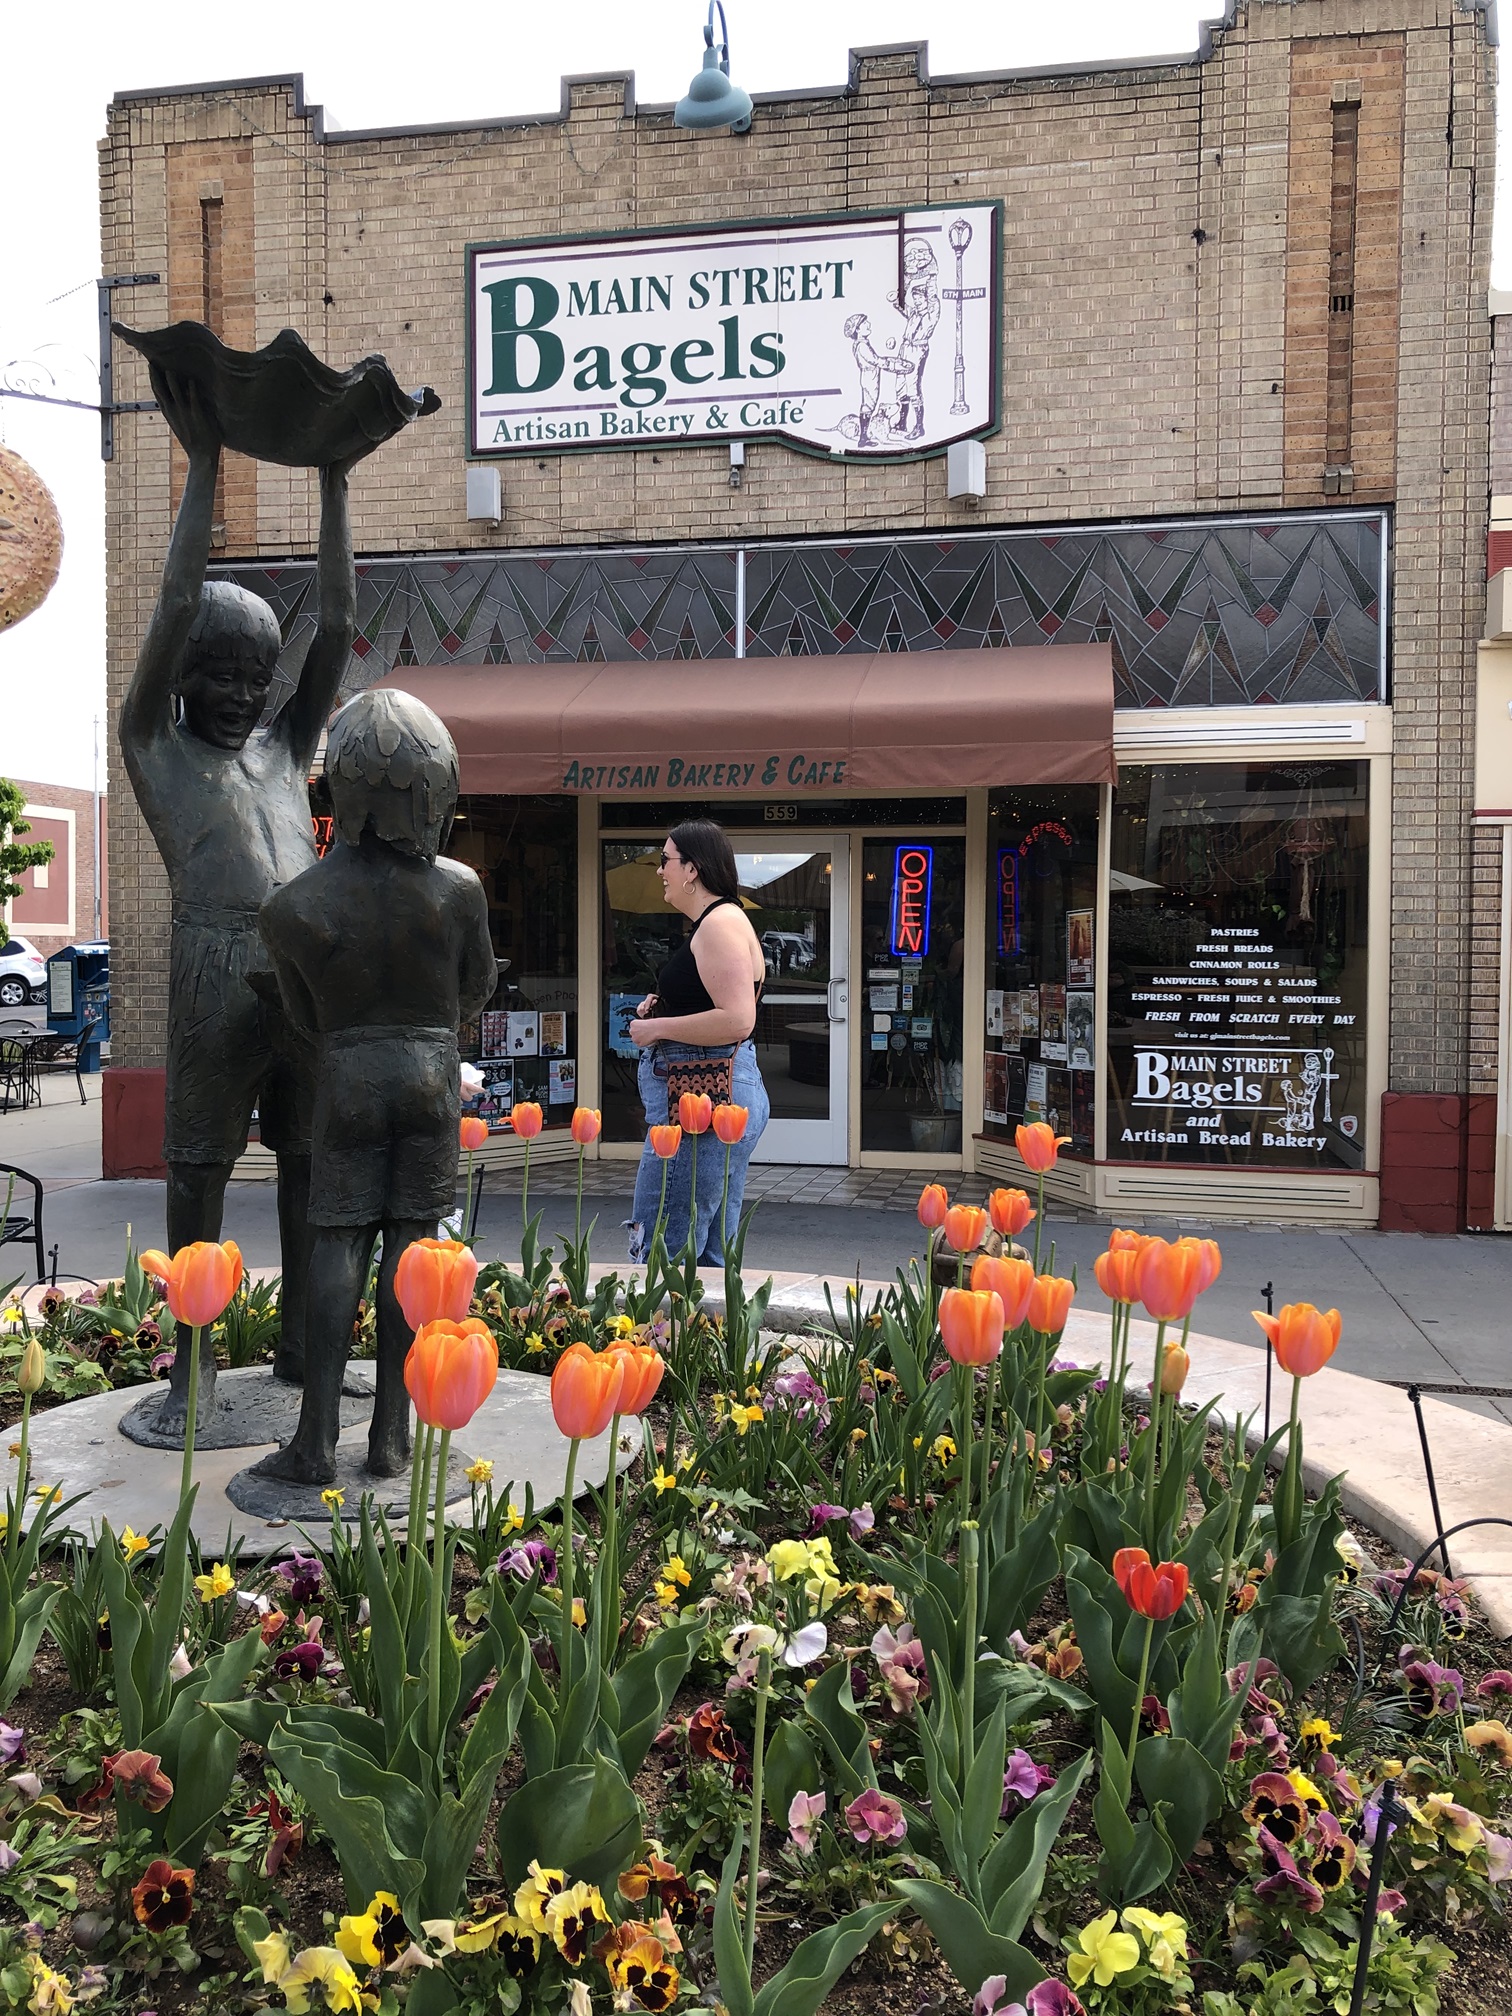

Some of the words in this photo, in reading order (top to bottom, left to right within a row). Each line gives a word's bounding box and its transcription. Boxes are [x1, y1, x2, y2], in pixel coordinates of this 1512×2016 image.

[566, 275, 673, 318] MAIN
[688, 260, 853, 309] STREET
[962, 289, 984, 298] MAIN
[481, 276, 787, 409] Bagels
[493, 418, 590, 444] Artisan
[599, 409, 695, 437] Bakery
[705, 405, 729, 428] &
[761, 756, 780, 785] &
[765, 806, 797, 819] 559
[899, 852, 927, 952] OPEN
[1210, 928, 1259, 937] PASTRIES
[1196, 945, 1229, 953] FRESH
[1233, 945, 1274, 953] BREADS
[1189, 961, 1243, 969] CINNAMON
[1247, 961, 1280, 970] ROLLS
[1152, 977, 1220, 987] SANDWICHES,
[1224, 978, 1259, 986] SOUPS
[1263, 978, 1272, 986] &
[1277, 978, 1318, 987] SALADS
[1131, 993, 1182, 1002] ESPRESSO
[1197, 994, 1230, 1002] FRESH
[1235, 994, 1263, 1003] JUICE
[1267, 995, 1276, 1003] &
[1282, 995, 1342, 1004] SMOOTHIES
[1144, 1011, 1181, 1022] FRESH
[1188, 1012, 1221, 1022] FROM
[1228, 1013, 1280, 1024] SCRATCH
[1288, 1014, 1326, 1024] EVERY
[1332, 1015, 1357, 1025] DAY
[1170, 1056, 1218, 1072] MAIN
[1222, 1057, 1292, 1074] STREET
[1132, 1052, 1263, 1109] Bagels
[1185, 1114, 1223, 1127] and
[1120, 1129, 1189, 1144] Artisan
[1199, 1130, 1251, 1146] Bread
[1262, 1133, 1328, 1151] Bakery
